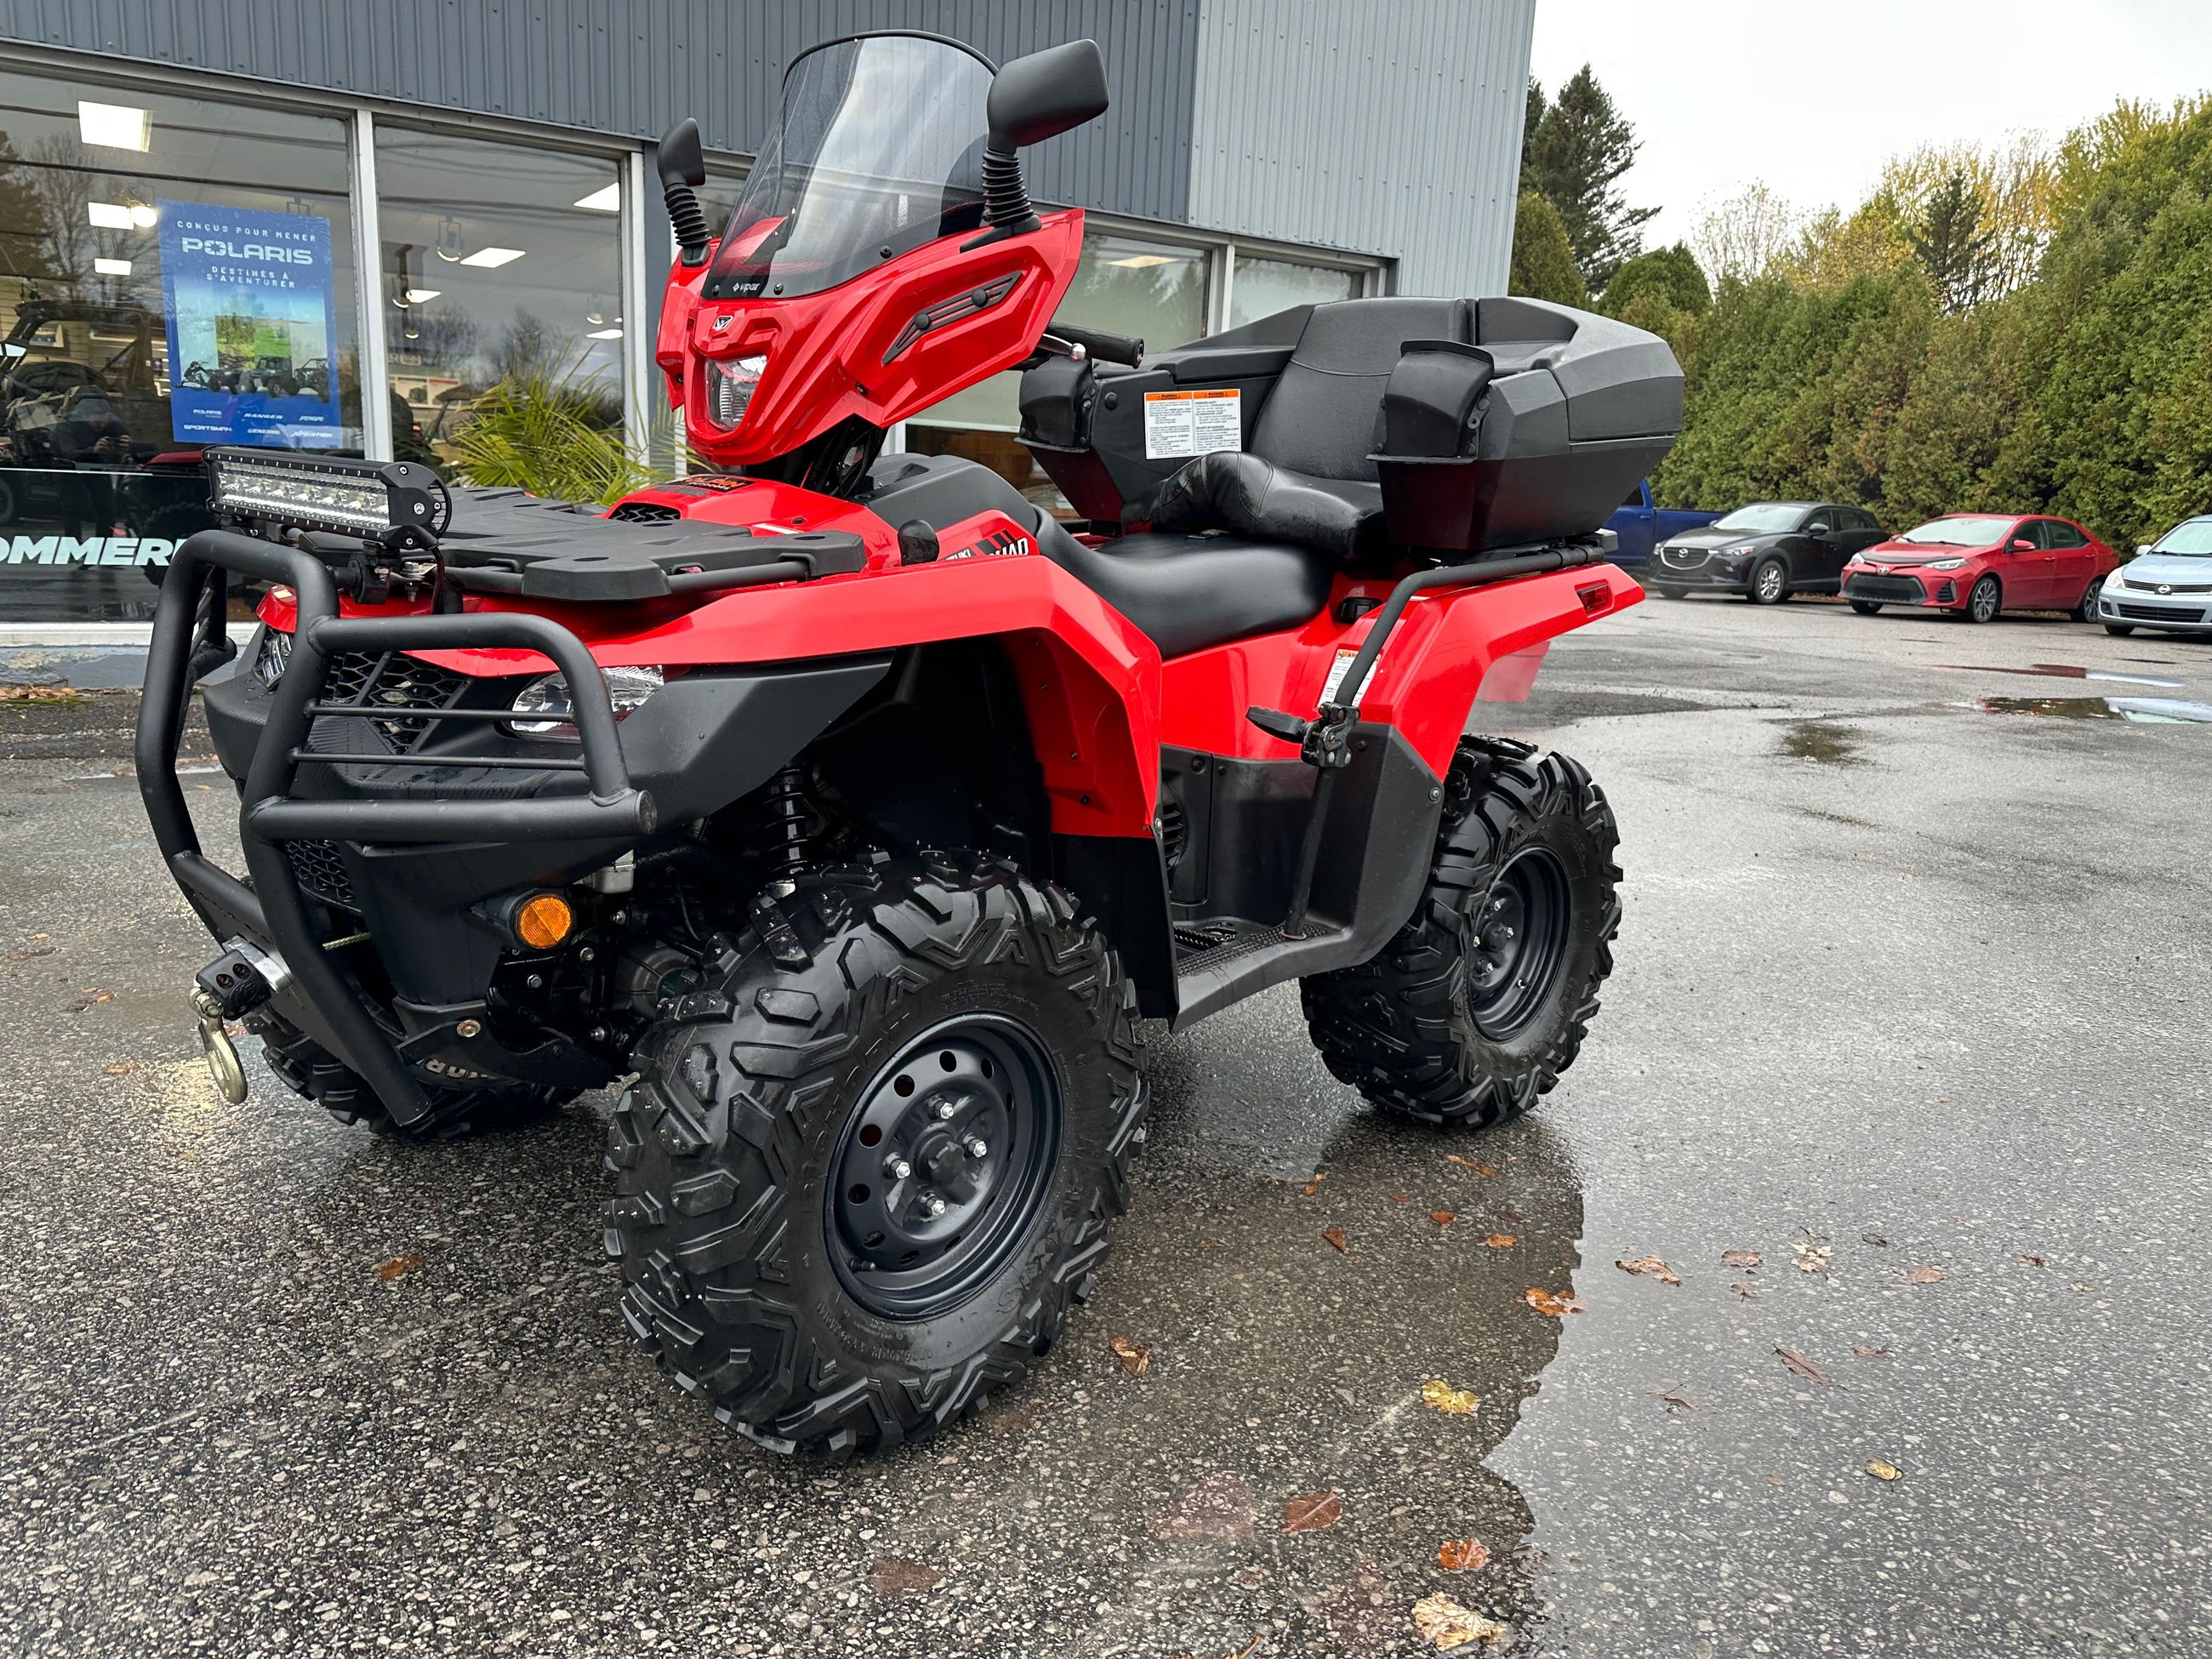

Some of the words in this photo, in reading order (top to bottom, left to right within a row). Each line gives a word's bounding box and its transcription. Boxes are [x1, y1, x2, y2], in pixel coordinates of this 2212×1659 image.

[177, 220, 228, 231] CONÇUS
[236, 226, 268, 237] POUR
[276, 231, 316, 242] MENER
[181, 237, 313, 265] POLARIS
[207, 273, 295, 288] S'AVENTURER
[0, 535, 187, 566] MMER
